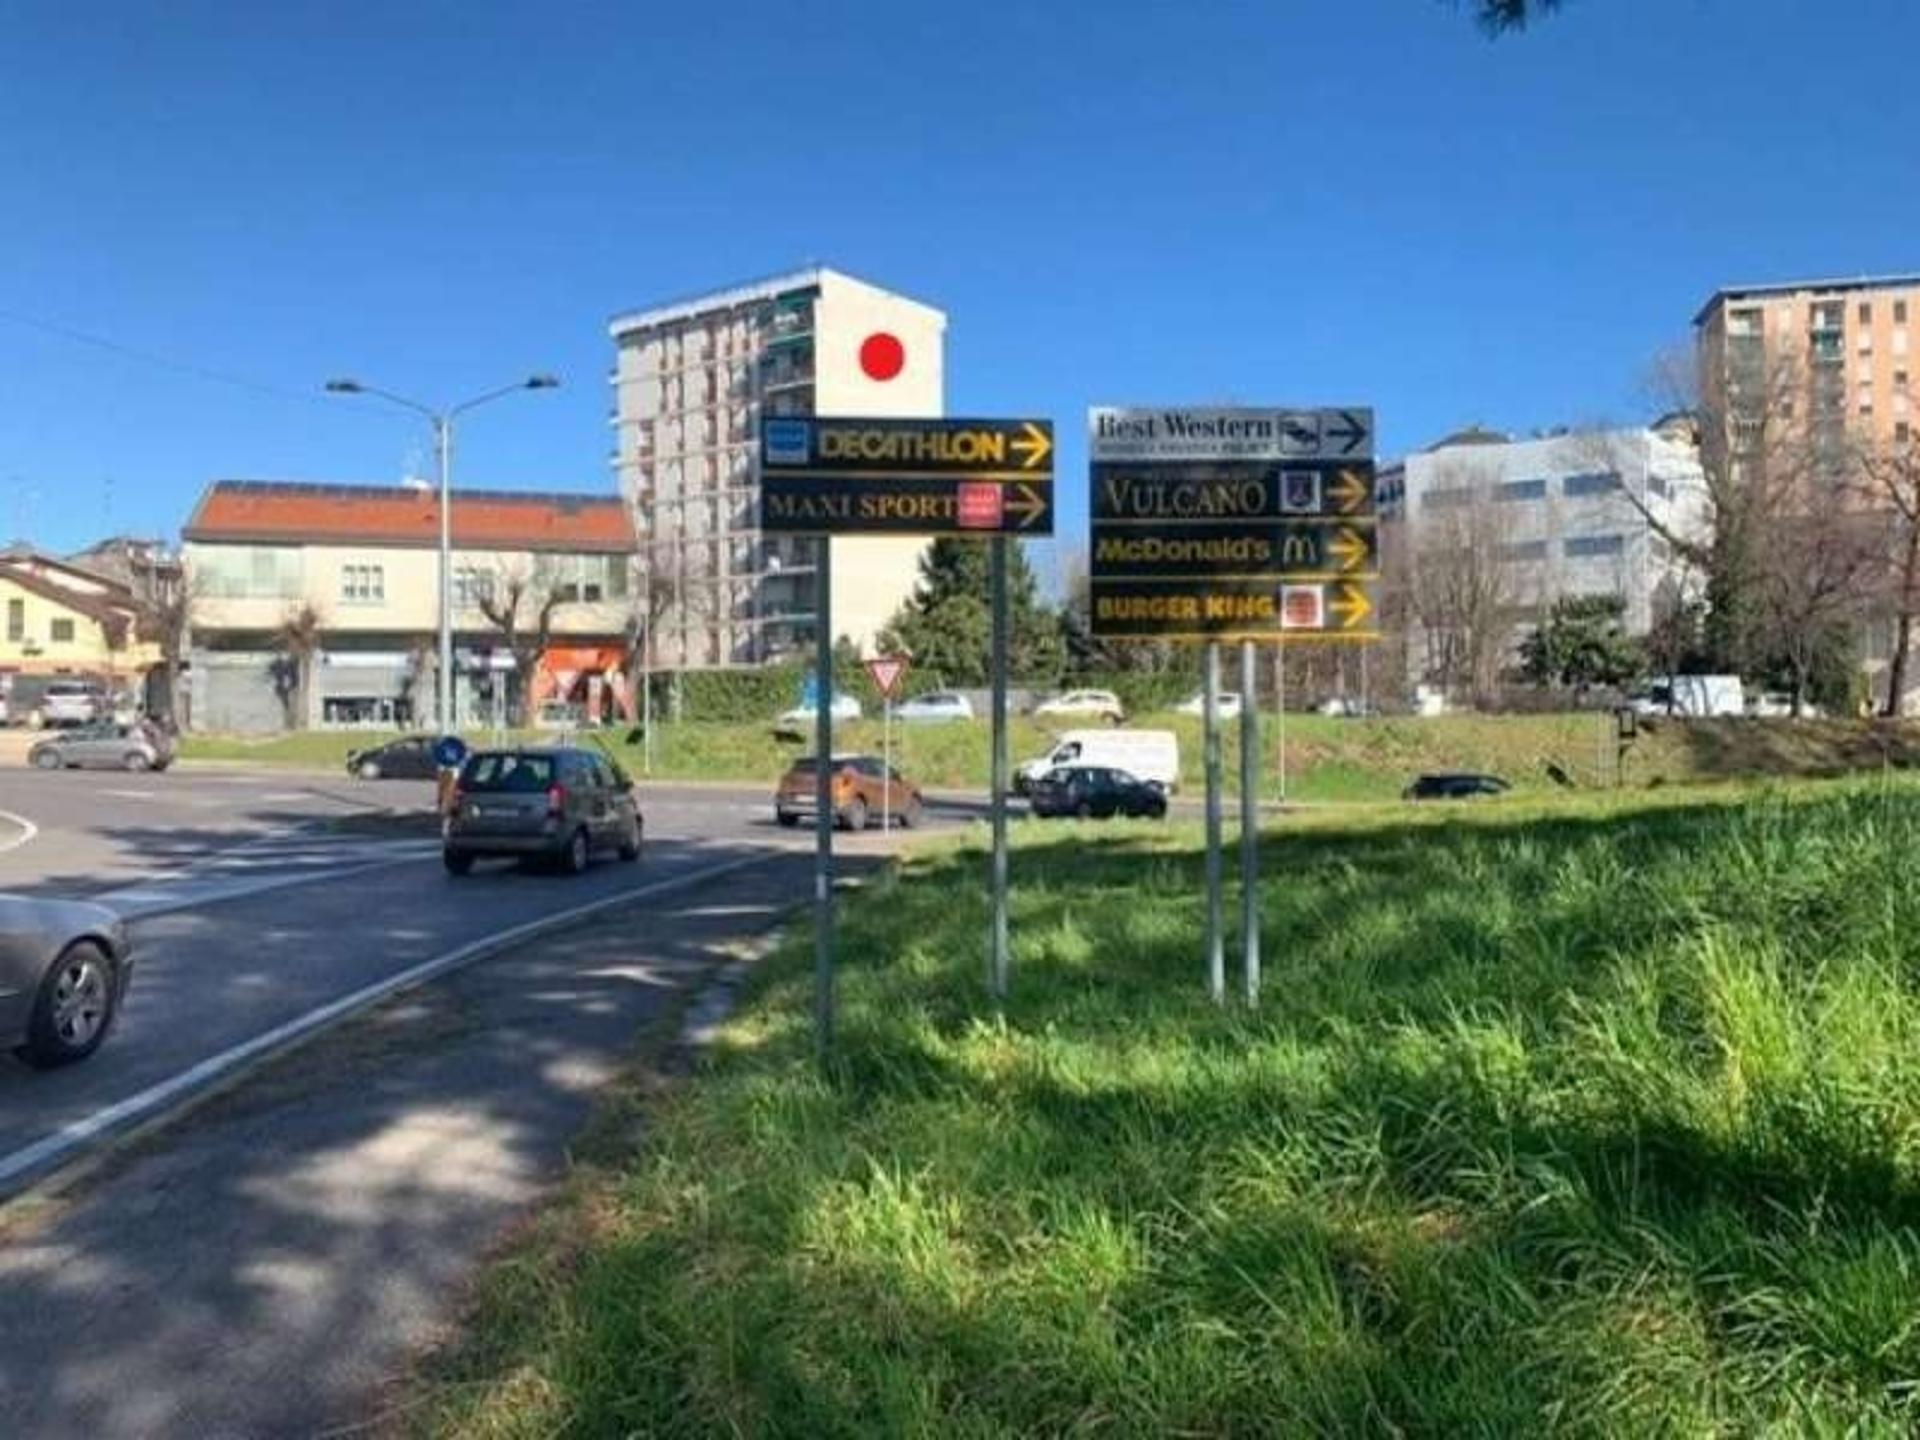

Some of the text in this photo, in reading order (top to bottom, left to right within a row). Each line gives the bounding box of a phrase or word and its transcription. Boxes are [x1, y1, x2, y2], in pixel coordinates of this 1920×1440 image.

[1098, 413, 1272, 438] Best Western
[817, 429, 1004, 460] DECATHLON
[769, 494, 848, 517] MAXI
[859, 494, 957, 519] SPORT
[1105, 479, 1268, 514] VULCANO
[1096, 537, 1271, 561] McDonald's
[1096, 596, 1200, 619] BURGER
[1206, 595, 1275, 618] KING
